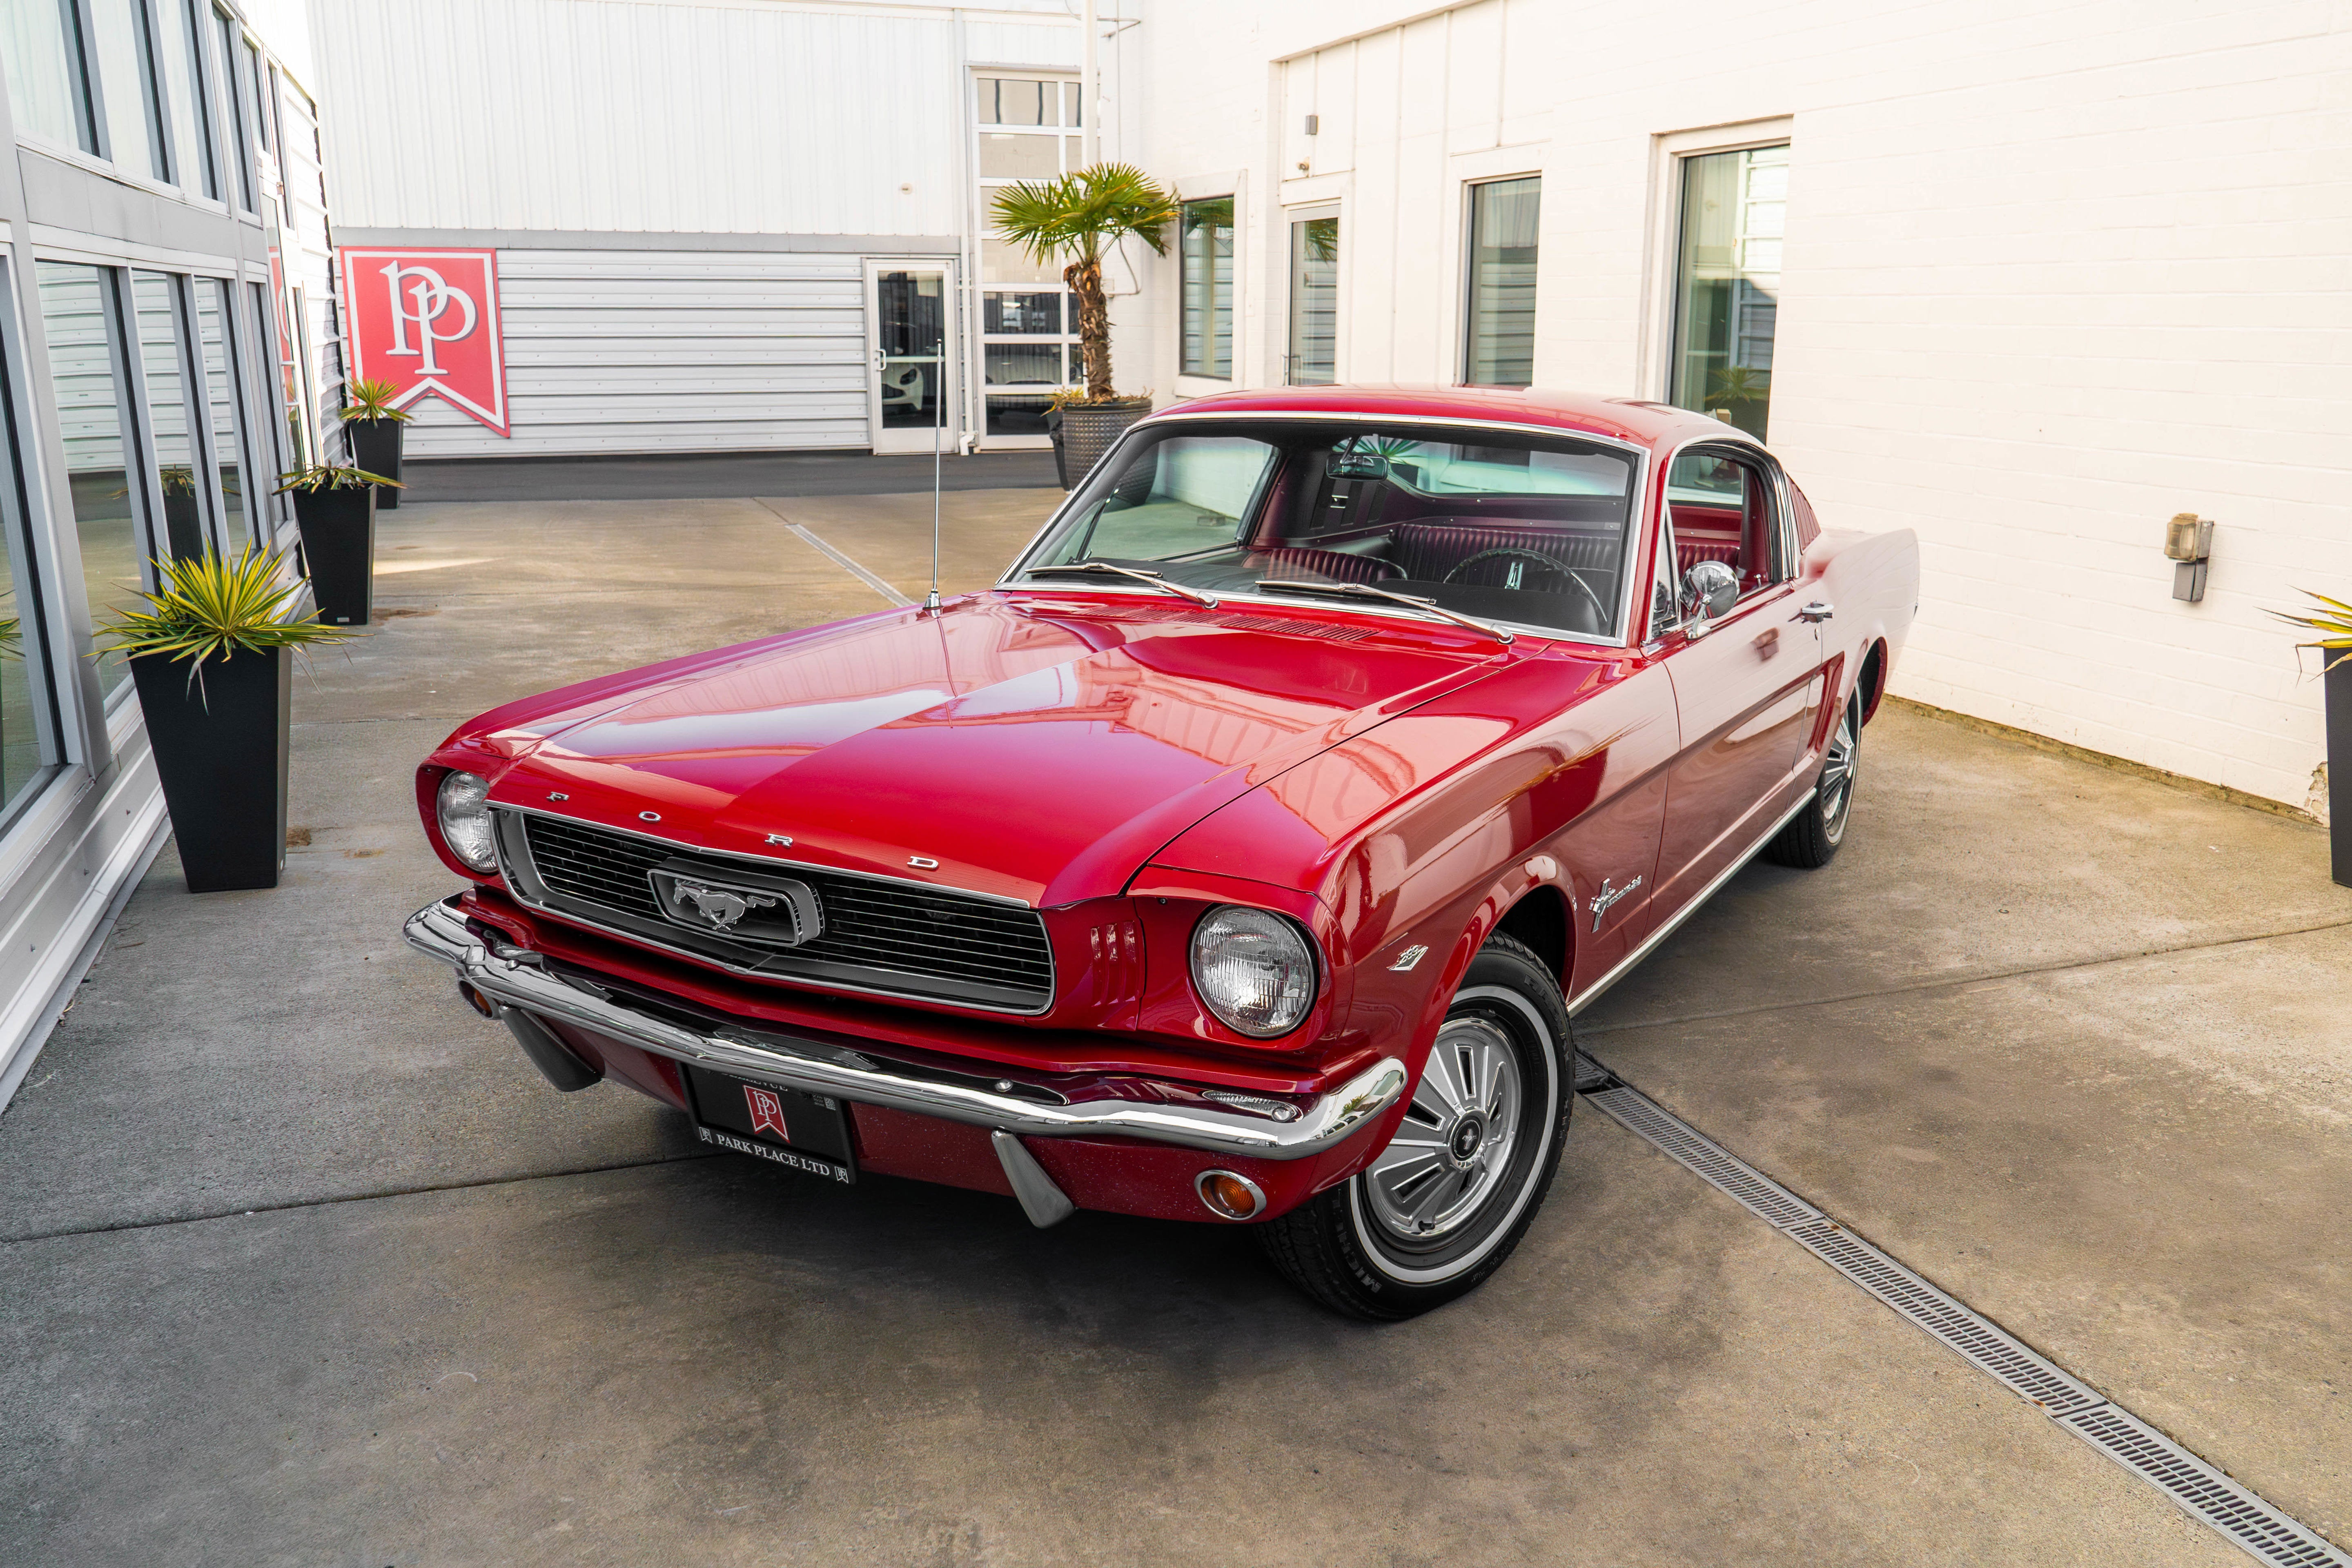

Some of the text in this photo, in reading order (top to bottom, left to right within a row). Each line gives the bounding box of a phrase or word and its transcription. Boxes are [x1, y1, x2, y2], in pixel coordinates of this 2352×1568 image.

[546, 791, 939, 871] FORD
[716, 1134, 753, 1153] PARK
[753, 1145, 798, 1167] PLACE
[801, 1158, 829, 1175] LTD
